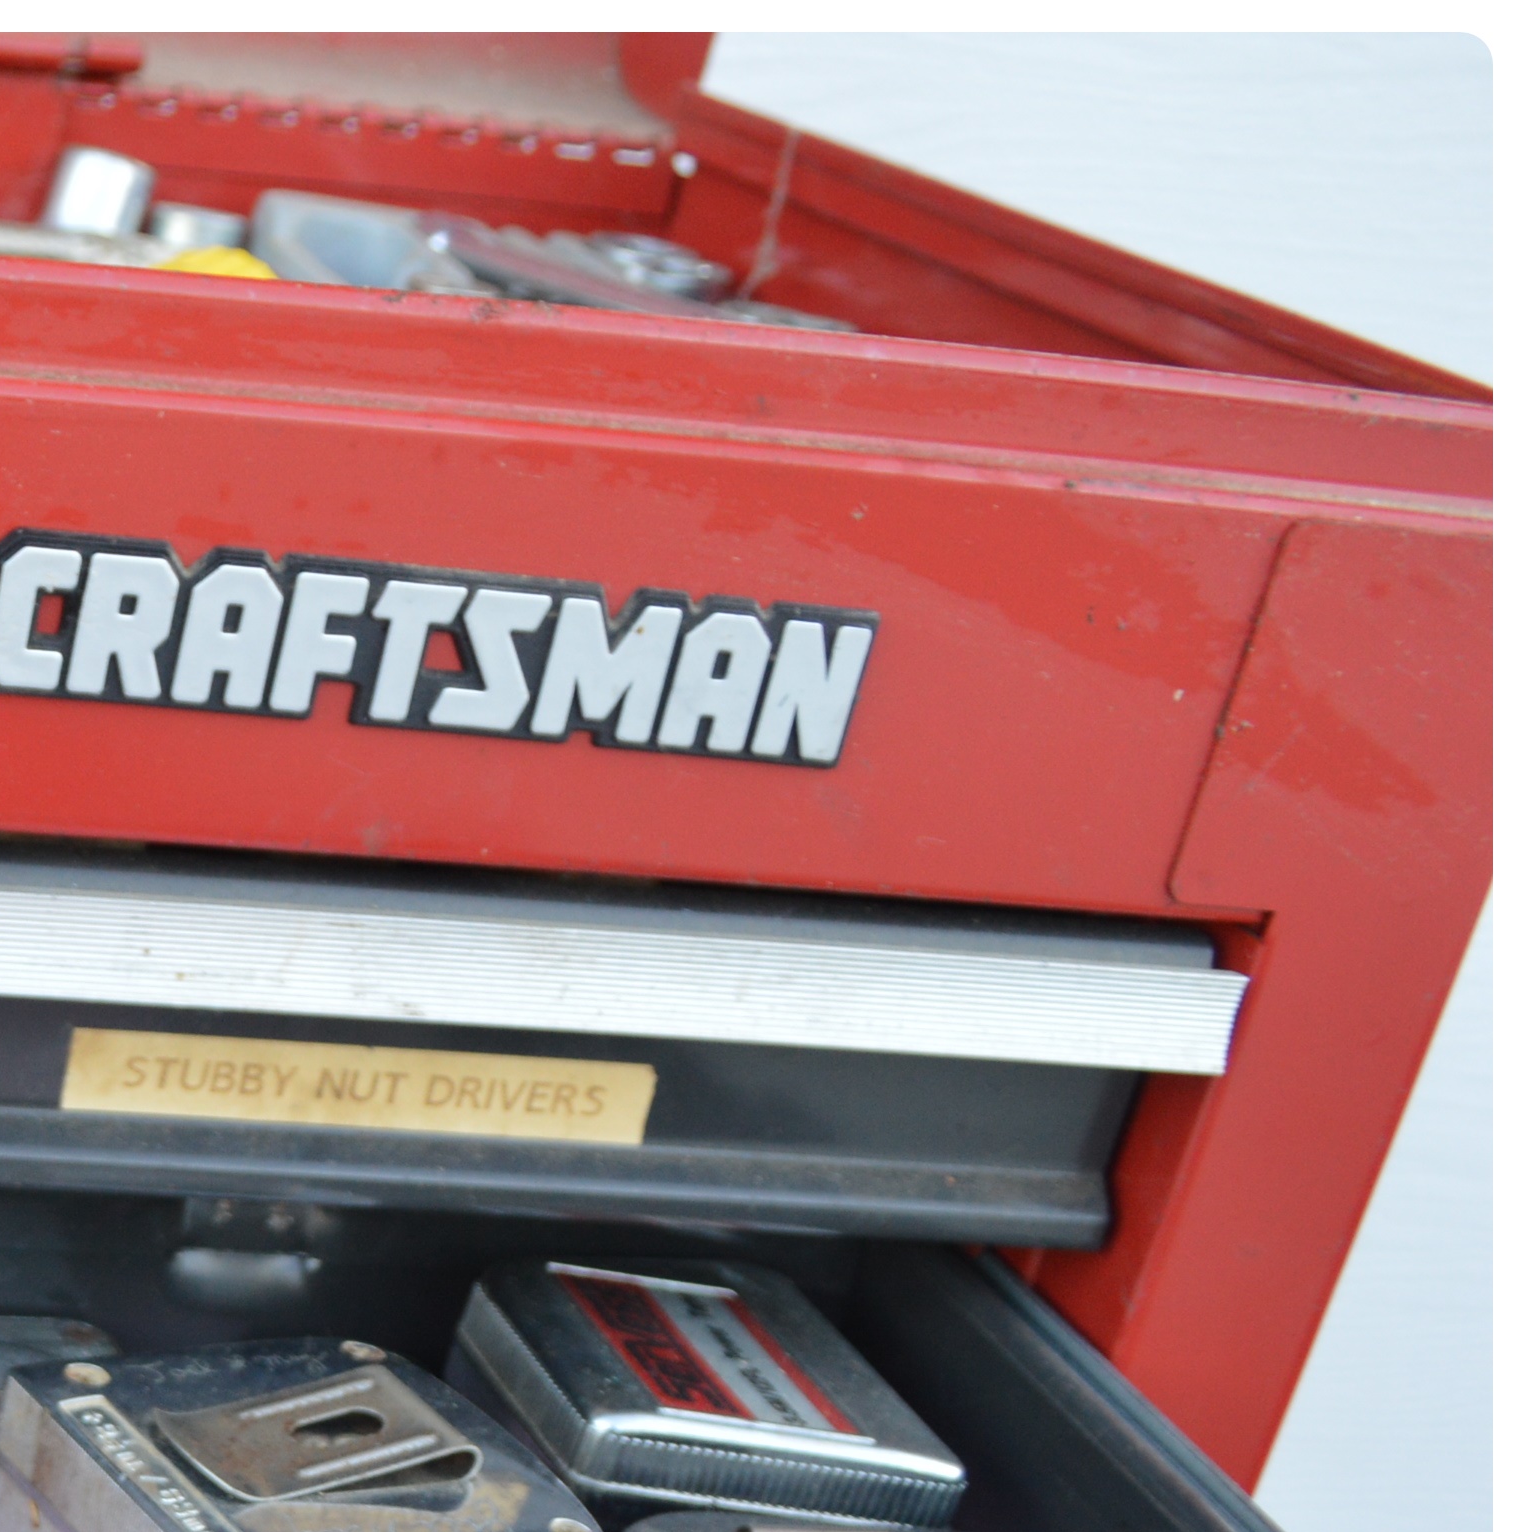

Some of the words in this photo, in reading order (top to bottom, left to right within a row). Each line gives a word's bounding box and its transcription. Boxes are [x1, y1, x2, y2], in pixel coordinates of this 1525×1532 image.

[123, 1055, 298, 1099] STUBBY
[314, 1068, 409, 1102] NUT
[423, 1073, 607, 1117] DRIVERS
